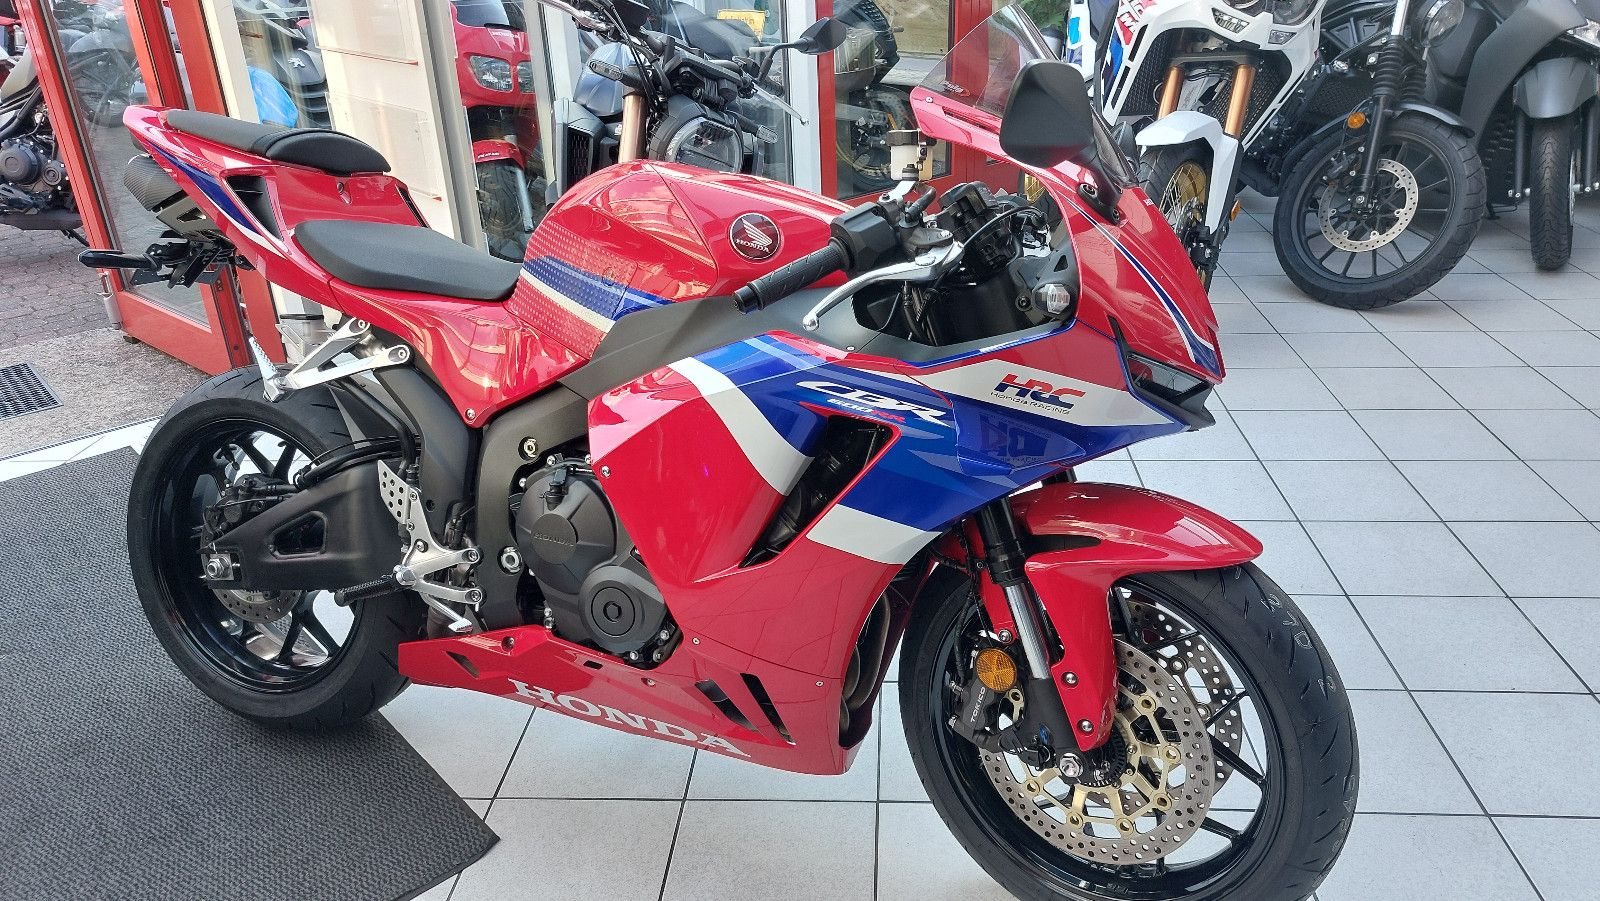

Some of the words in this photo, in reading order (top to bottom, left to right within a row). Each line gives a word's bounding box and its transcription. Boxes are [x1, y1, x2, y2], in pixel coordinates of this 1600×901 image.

[736, 238, 771, 254] HONDA
[795, 380, 952, 428] CBR
[990, 391, 1028, 406] HONDA
[1029, 401, 1071, 416] RACING
[994, 373, 1087, 410] HRC
[533, 531, 575, 548] HONDA
[507, 677, 752, 758] HONDA
[970, 686, 986, 723] TOKICO
